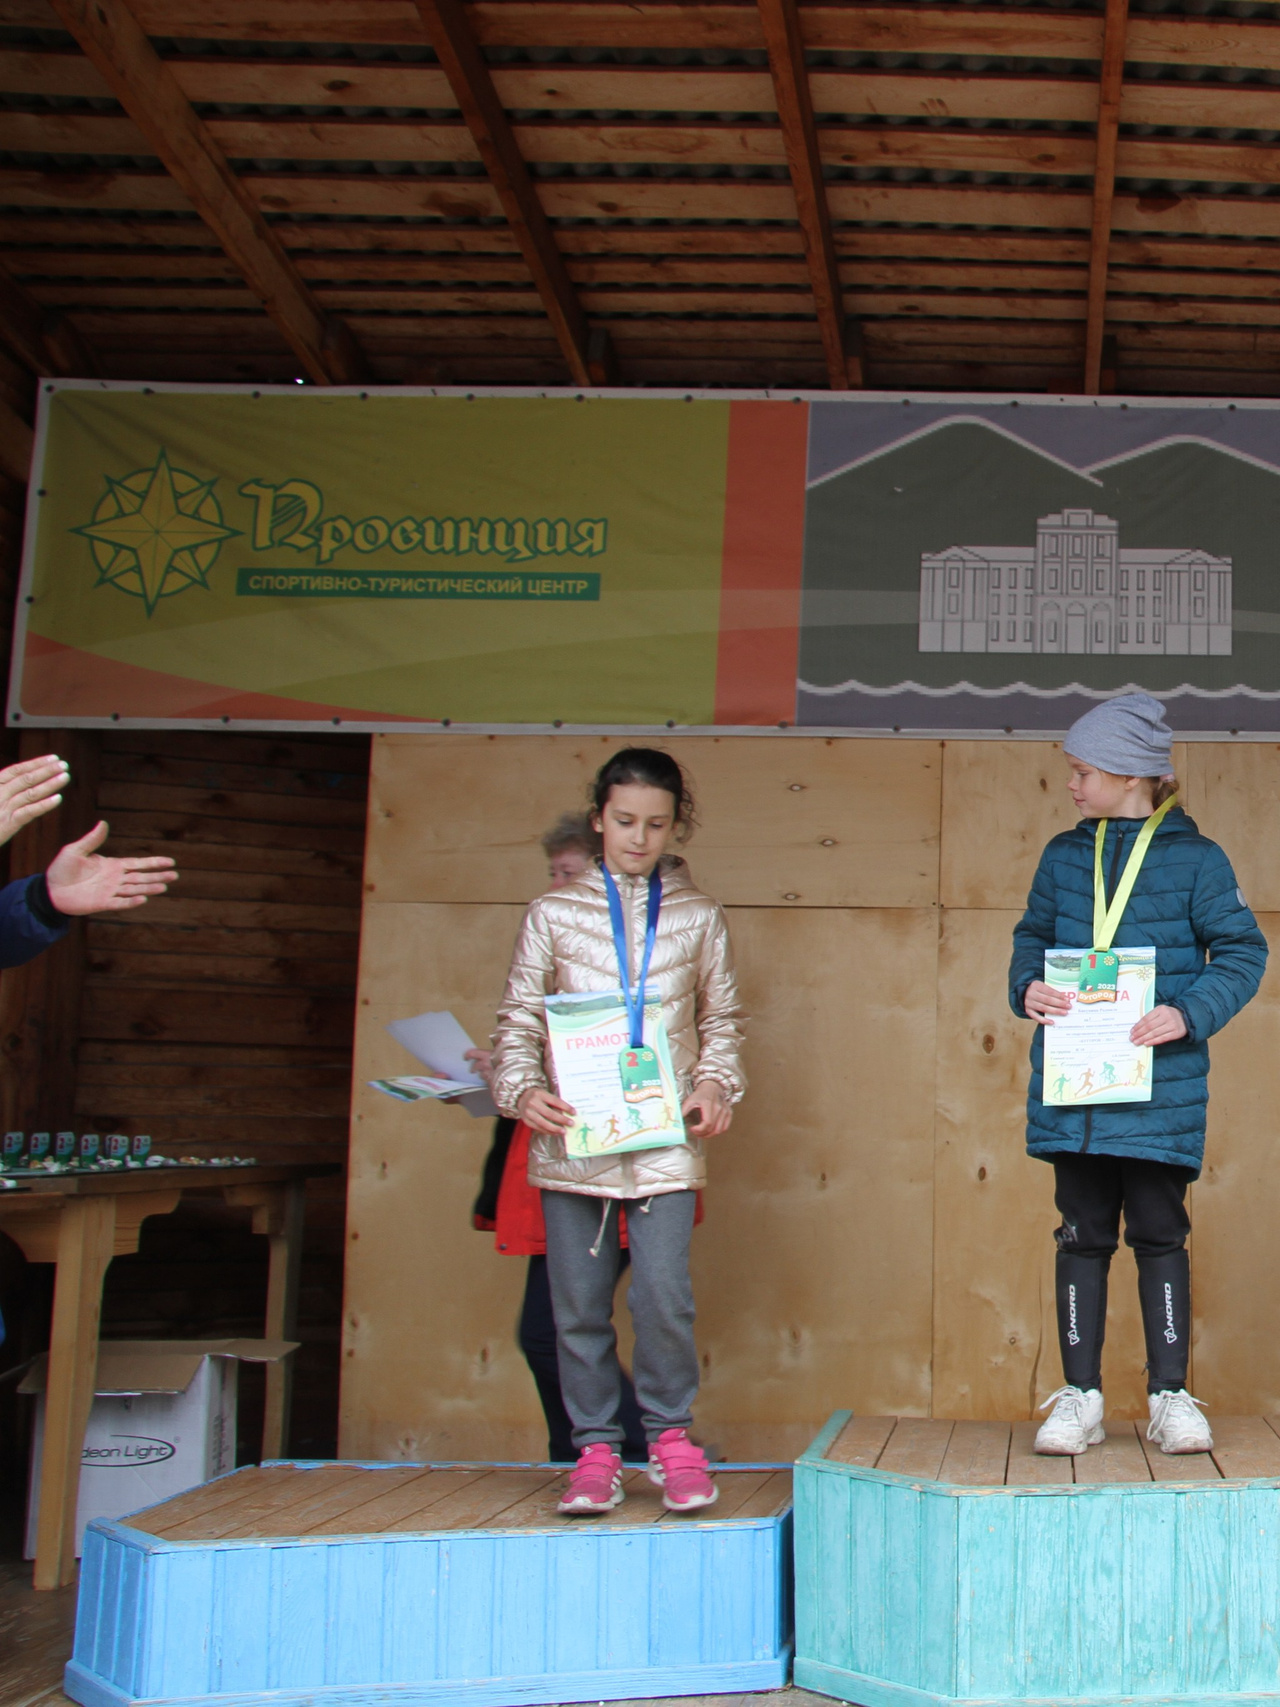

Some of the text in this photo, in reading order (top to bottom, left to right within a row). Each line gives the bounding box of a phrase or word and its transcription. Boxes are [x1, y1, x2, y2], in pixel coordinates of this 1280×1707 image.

[249, 575, 589, 596] СПОРТИВНО-ТУРИСТИЧЕСКИЙ ЦЕНТР
[1087, 954, 1097, 969] 1
[565, 1032, 631, 1050] ГРАМОТ
[625, 1052, 639, 1067] 2
[1068, 1283, 1077, 1330] NORD
[1164, 1282, 1174, 1329] NORD
[81, 1445, 169, 1459] deon Light
